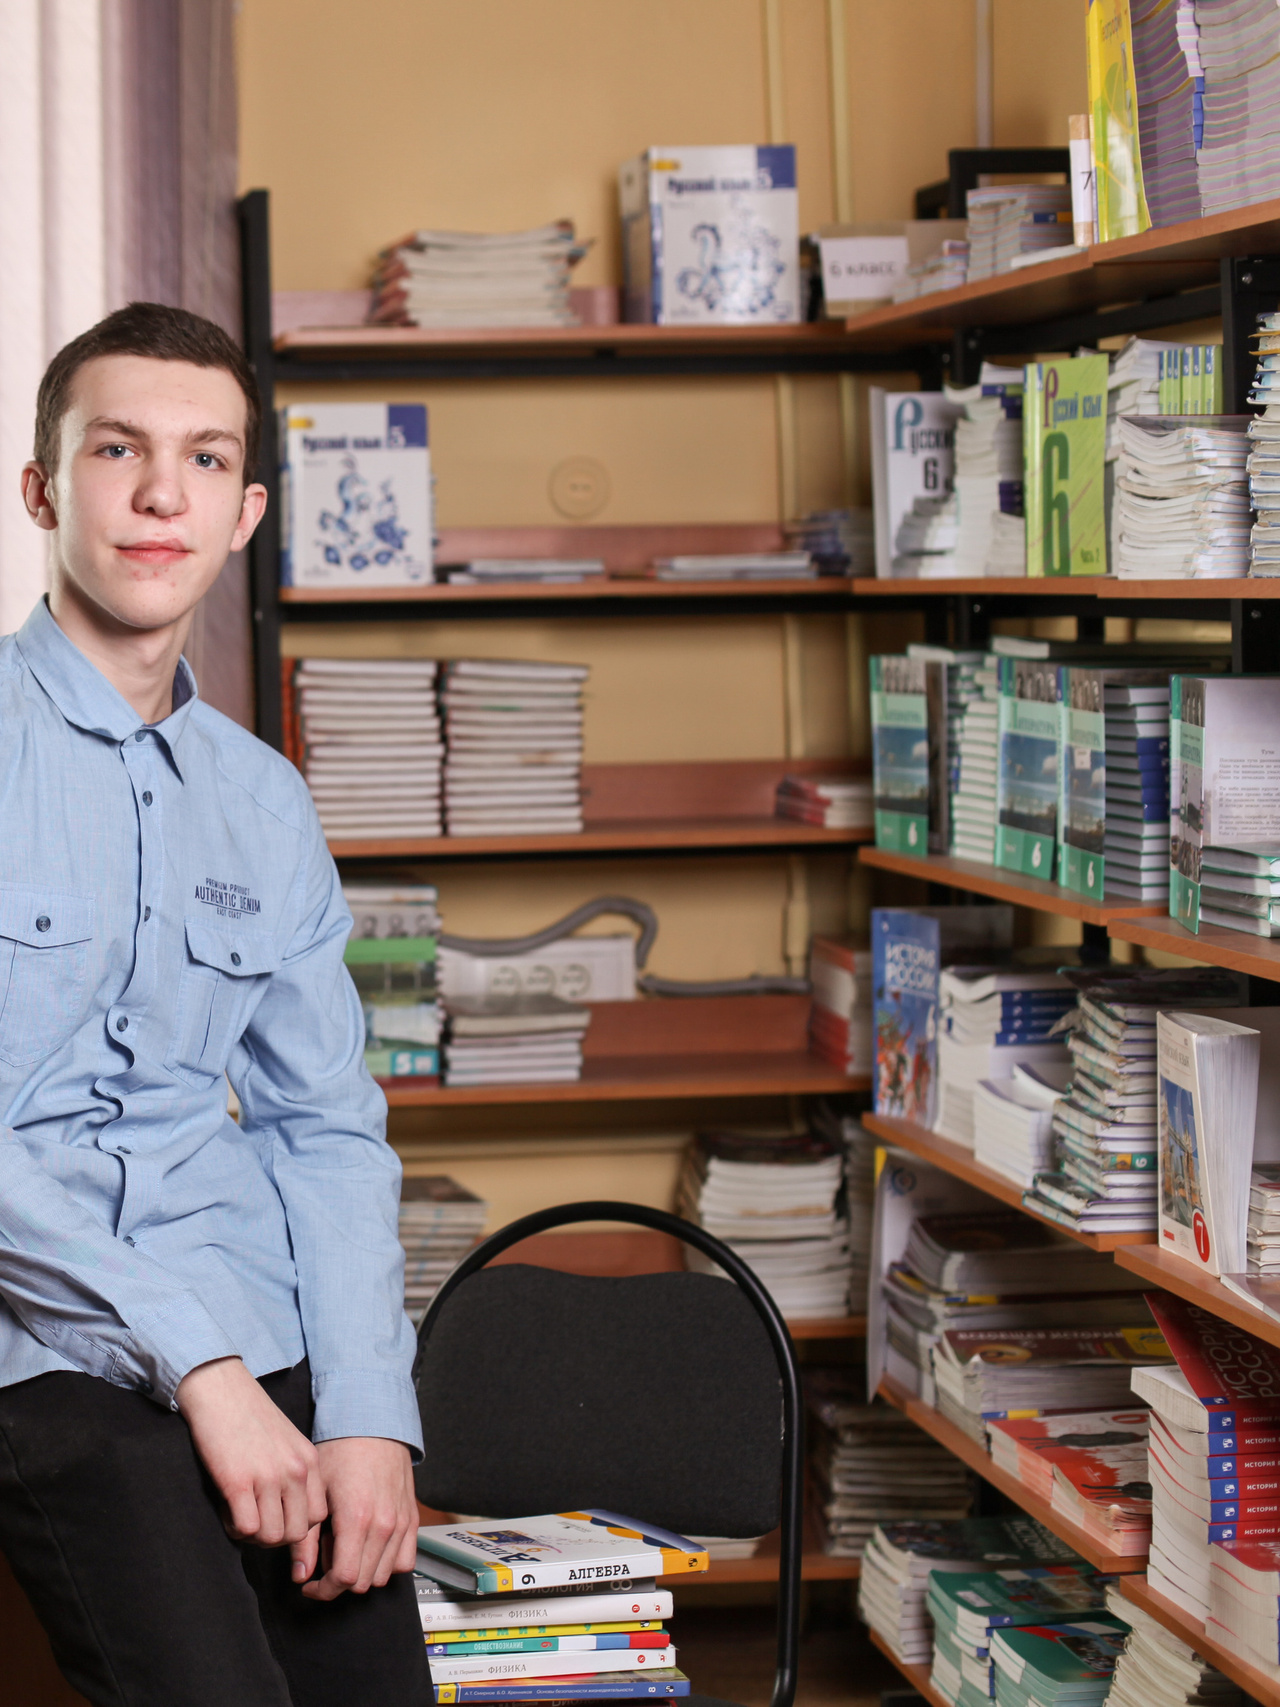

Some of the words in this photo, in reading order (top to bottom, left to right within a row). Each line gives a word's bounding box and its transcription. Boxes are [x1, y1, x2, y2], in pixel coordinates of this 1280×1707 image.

[1080, 170, 1093, 191] 7
[924, 458, 938, 489] 6
[1043, 431, 1070, 577] 6
[1032, 841, 1042, 869] 6
[1087, 861, 1095, 888] 6
[205, 877, 227, 891] PREMIUM
[230, 883, 250, 896] PRODUCT
[195, 885, 237, 908] AUTHENTIC
[240, 896, 261, 913] DENIM
[1196, 1219, 1205, 1254] 7
[1187, 1306, 1256, 1399] ИСТОРИЯ
[1220, 1318, 1280, 1398] РОССИ
[1245, 1437, 1276, 1445] ИСТОРИЯ
[1244, 1460, 1276, 1468] ИСТОРИЯ
[1247, 1505, 1277, 1513] ИСТОРИЯ
[1244, 1527, 1275, 1535] ИСТОРИЯ
[568, 1563, 631, 1581] АЛГЕБРА
[508, 1609, 548, 1619] ФИЗИКА
[473, 1642, 524, 1651] ОБЩЕСТВОЗНАНИЕ
[488, 1664, 527, 1674] ФИЗИКА
